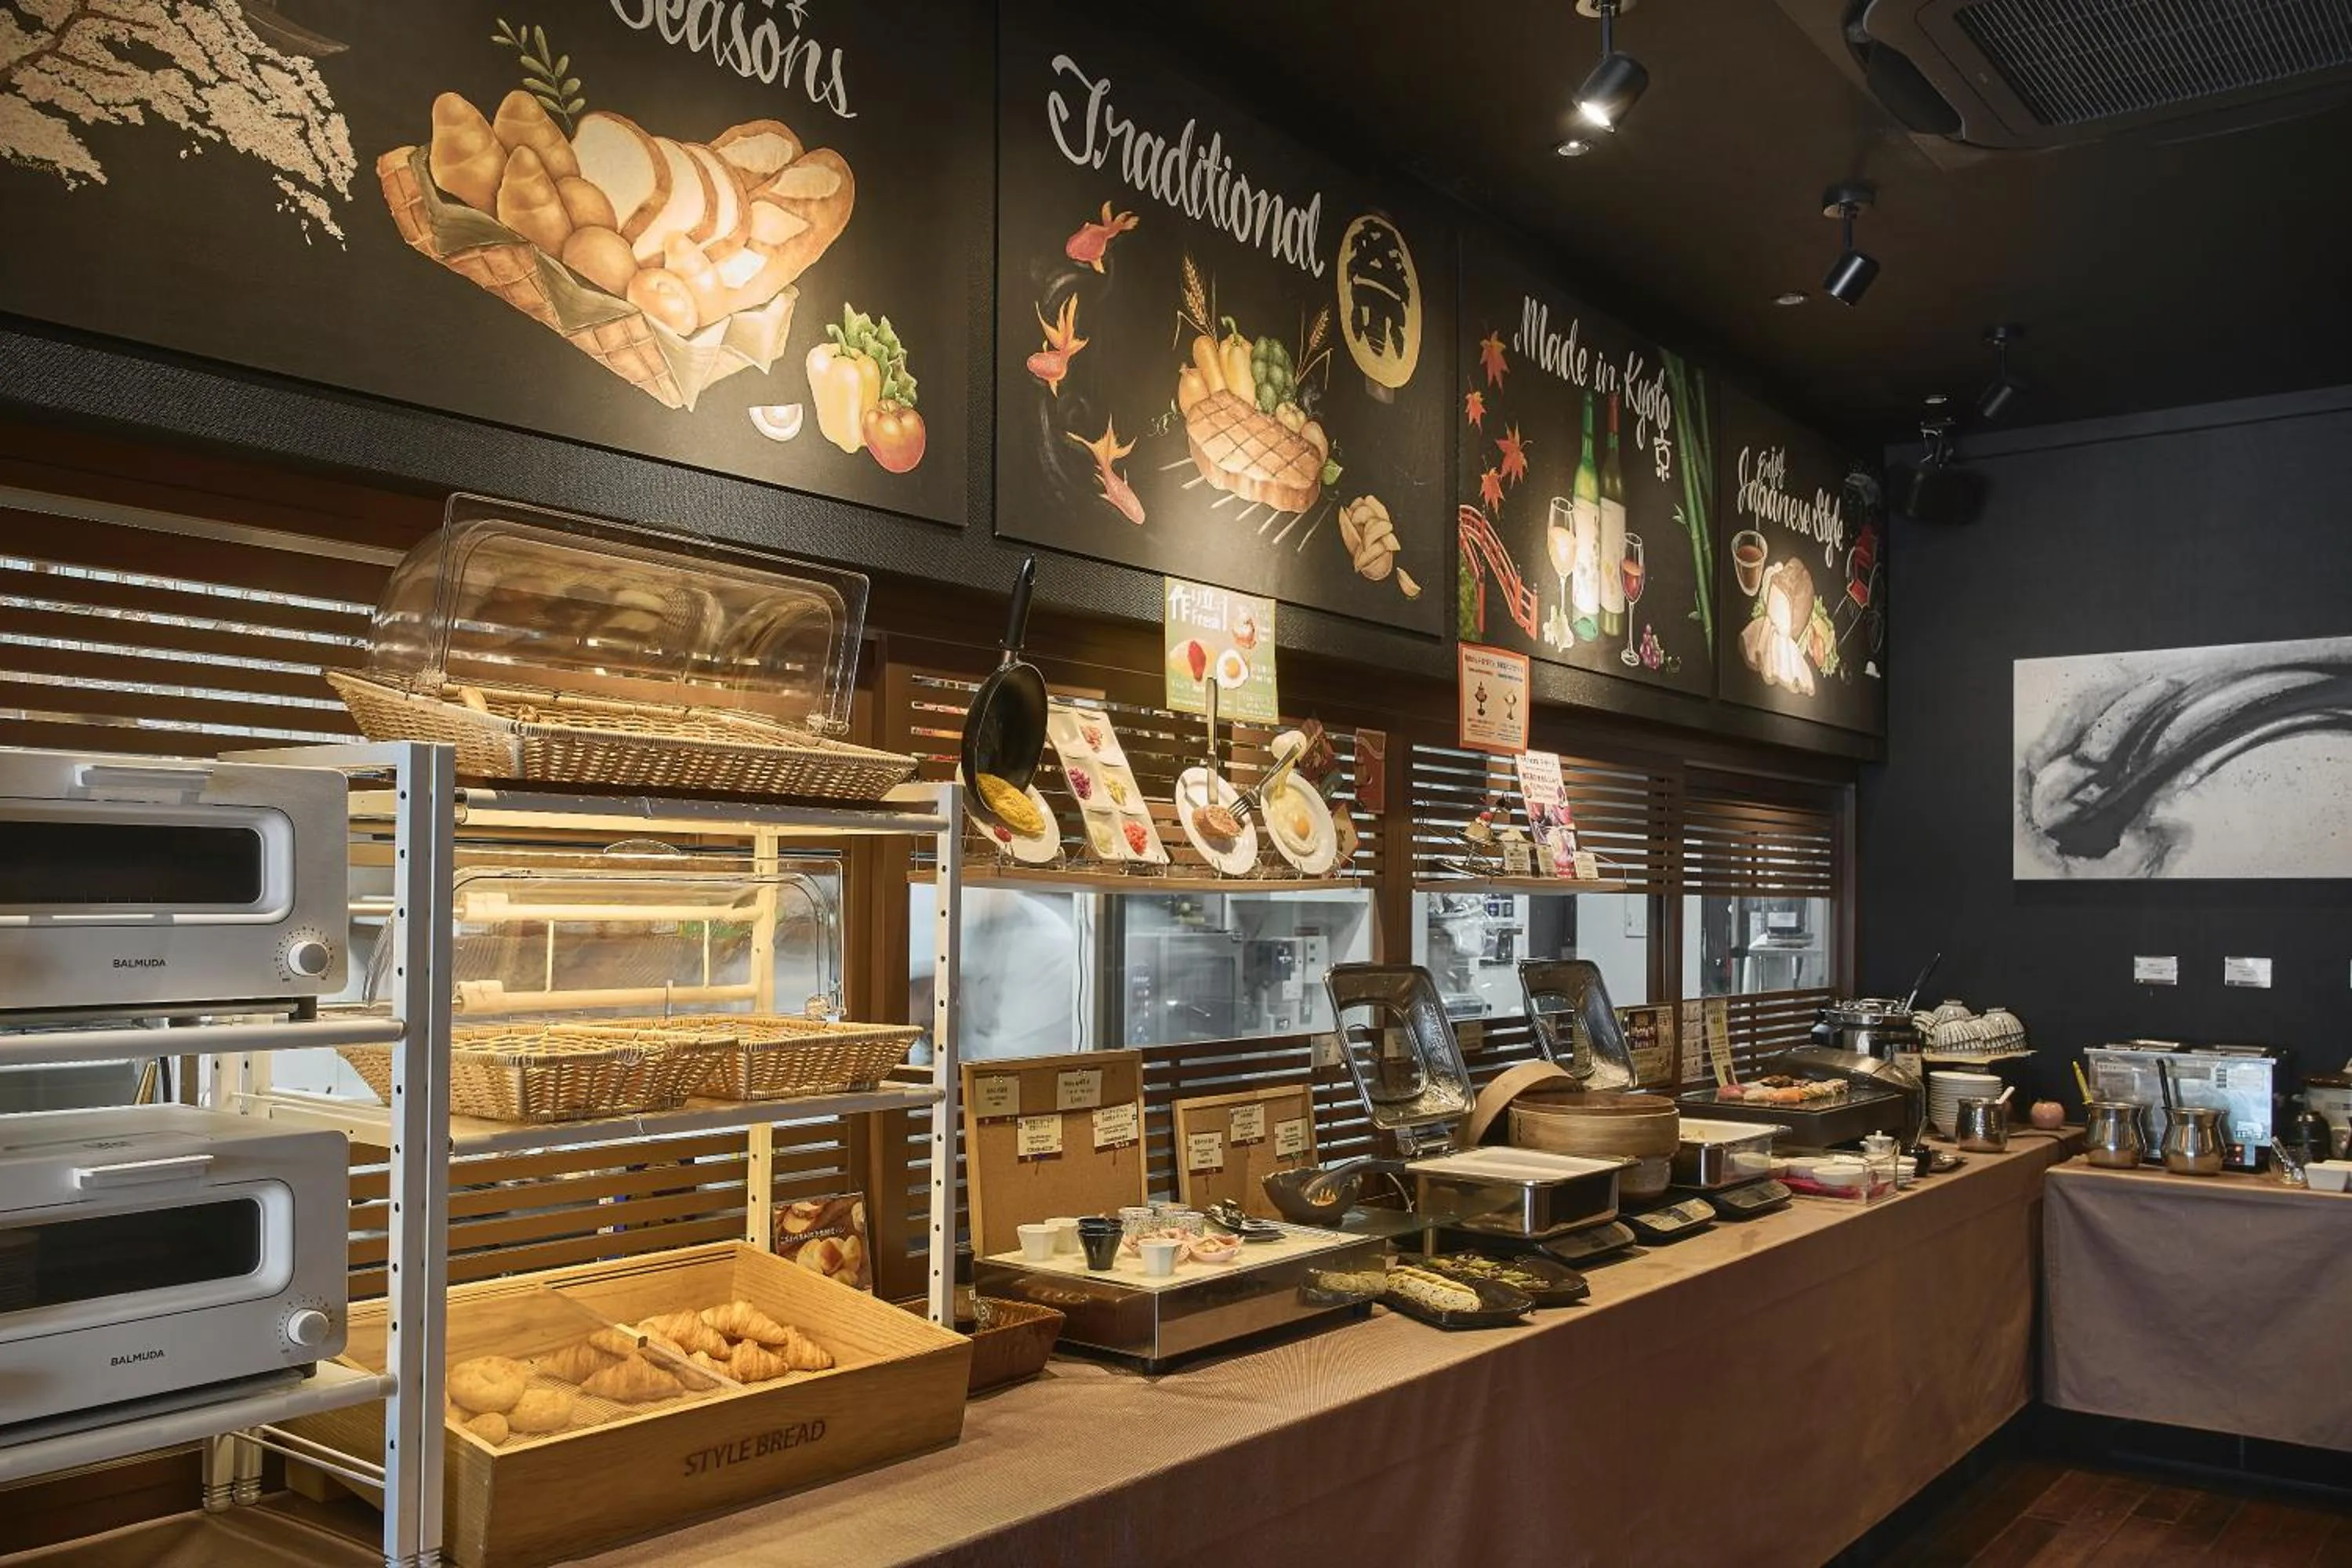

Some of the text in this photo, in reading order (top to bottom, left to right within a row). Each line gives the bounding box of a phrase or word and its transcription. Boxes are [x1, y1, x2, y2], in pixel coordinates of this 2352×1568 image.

[609, 0, 858, 118] easons
[1048, 54, 1325, 278] Traditional
[1514, 295, 1671, 451] Made in Kyoto
[1653, 430, 1671, 481] 京
[1757, 445, 1785, 490] Enjoy
[1737, 445, 1843, 568] Japanese Style
[112, 958, 166, 969] BALMUDA
[111, 1348, 165, 1367] BALMUDA
[684, 1420, 826, 1476] STYLE BREAD
